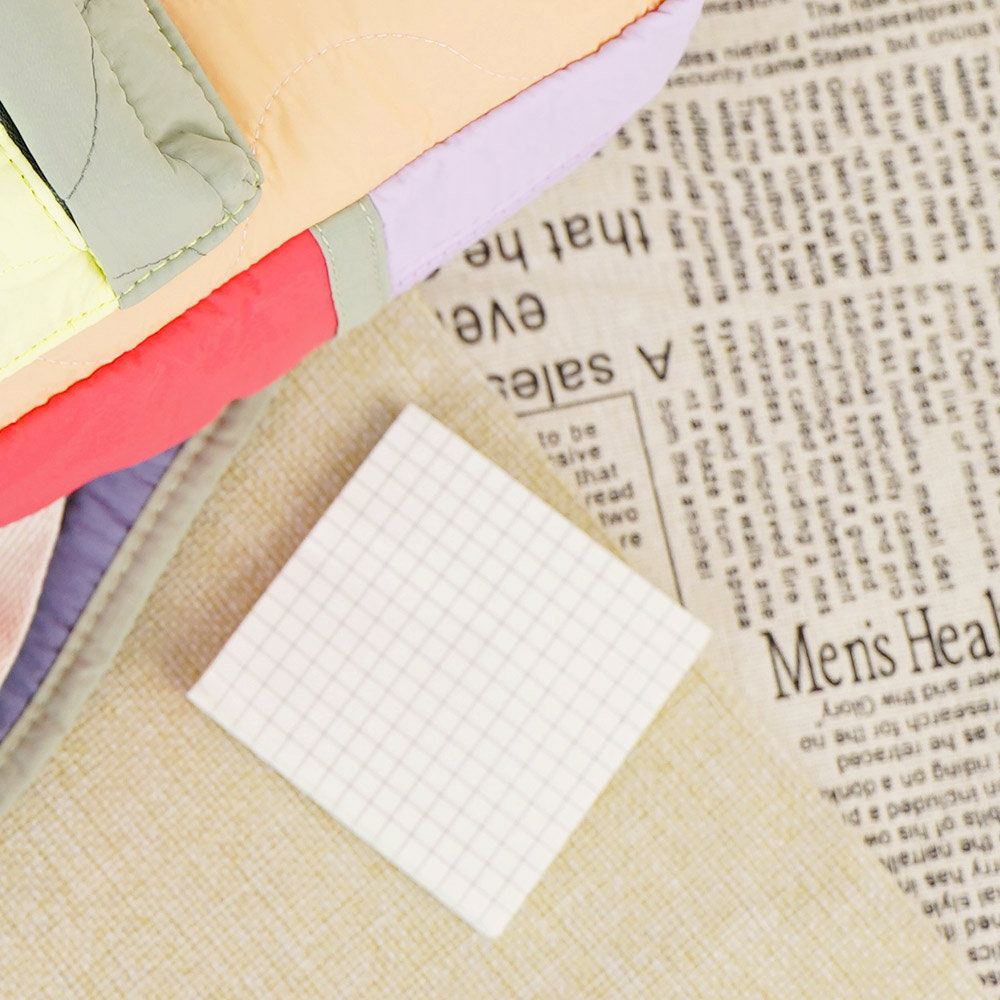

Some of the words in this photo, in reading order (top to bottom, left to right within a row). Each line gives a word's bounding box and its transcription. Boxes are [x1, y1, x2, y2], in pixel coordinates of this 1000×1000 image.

[463, 227, 529, 273] he
[542, 208, 650, 263] that
[434, 292, 546, 347] eve
[636, 338, 673, 382] A
[574, 463, 618, 488] that
[931, 756, 991, 781] riding
[887, 786, 979, 820] included
[960, 835, 993, 854] the
[924, 869, 964, 888] has
